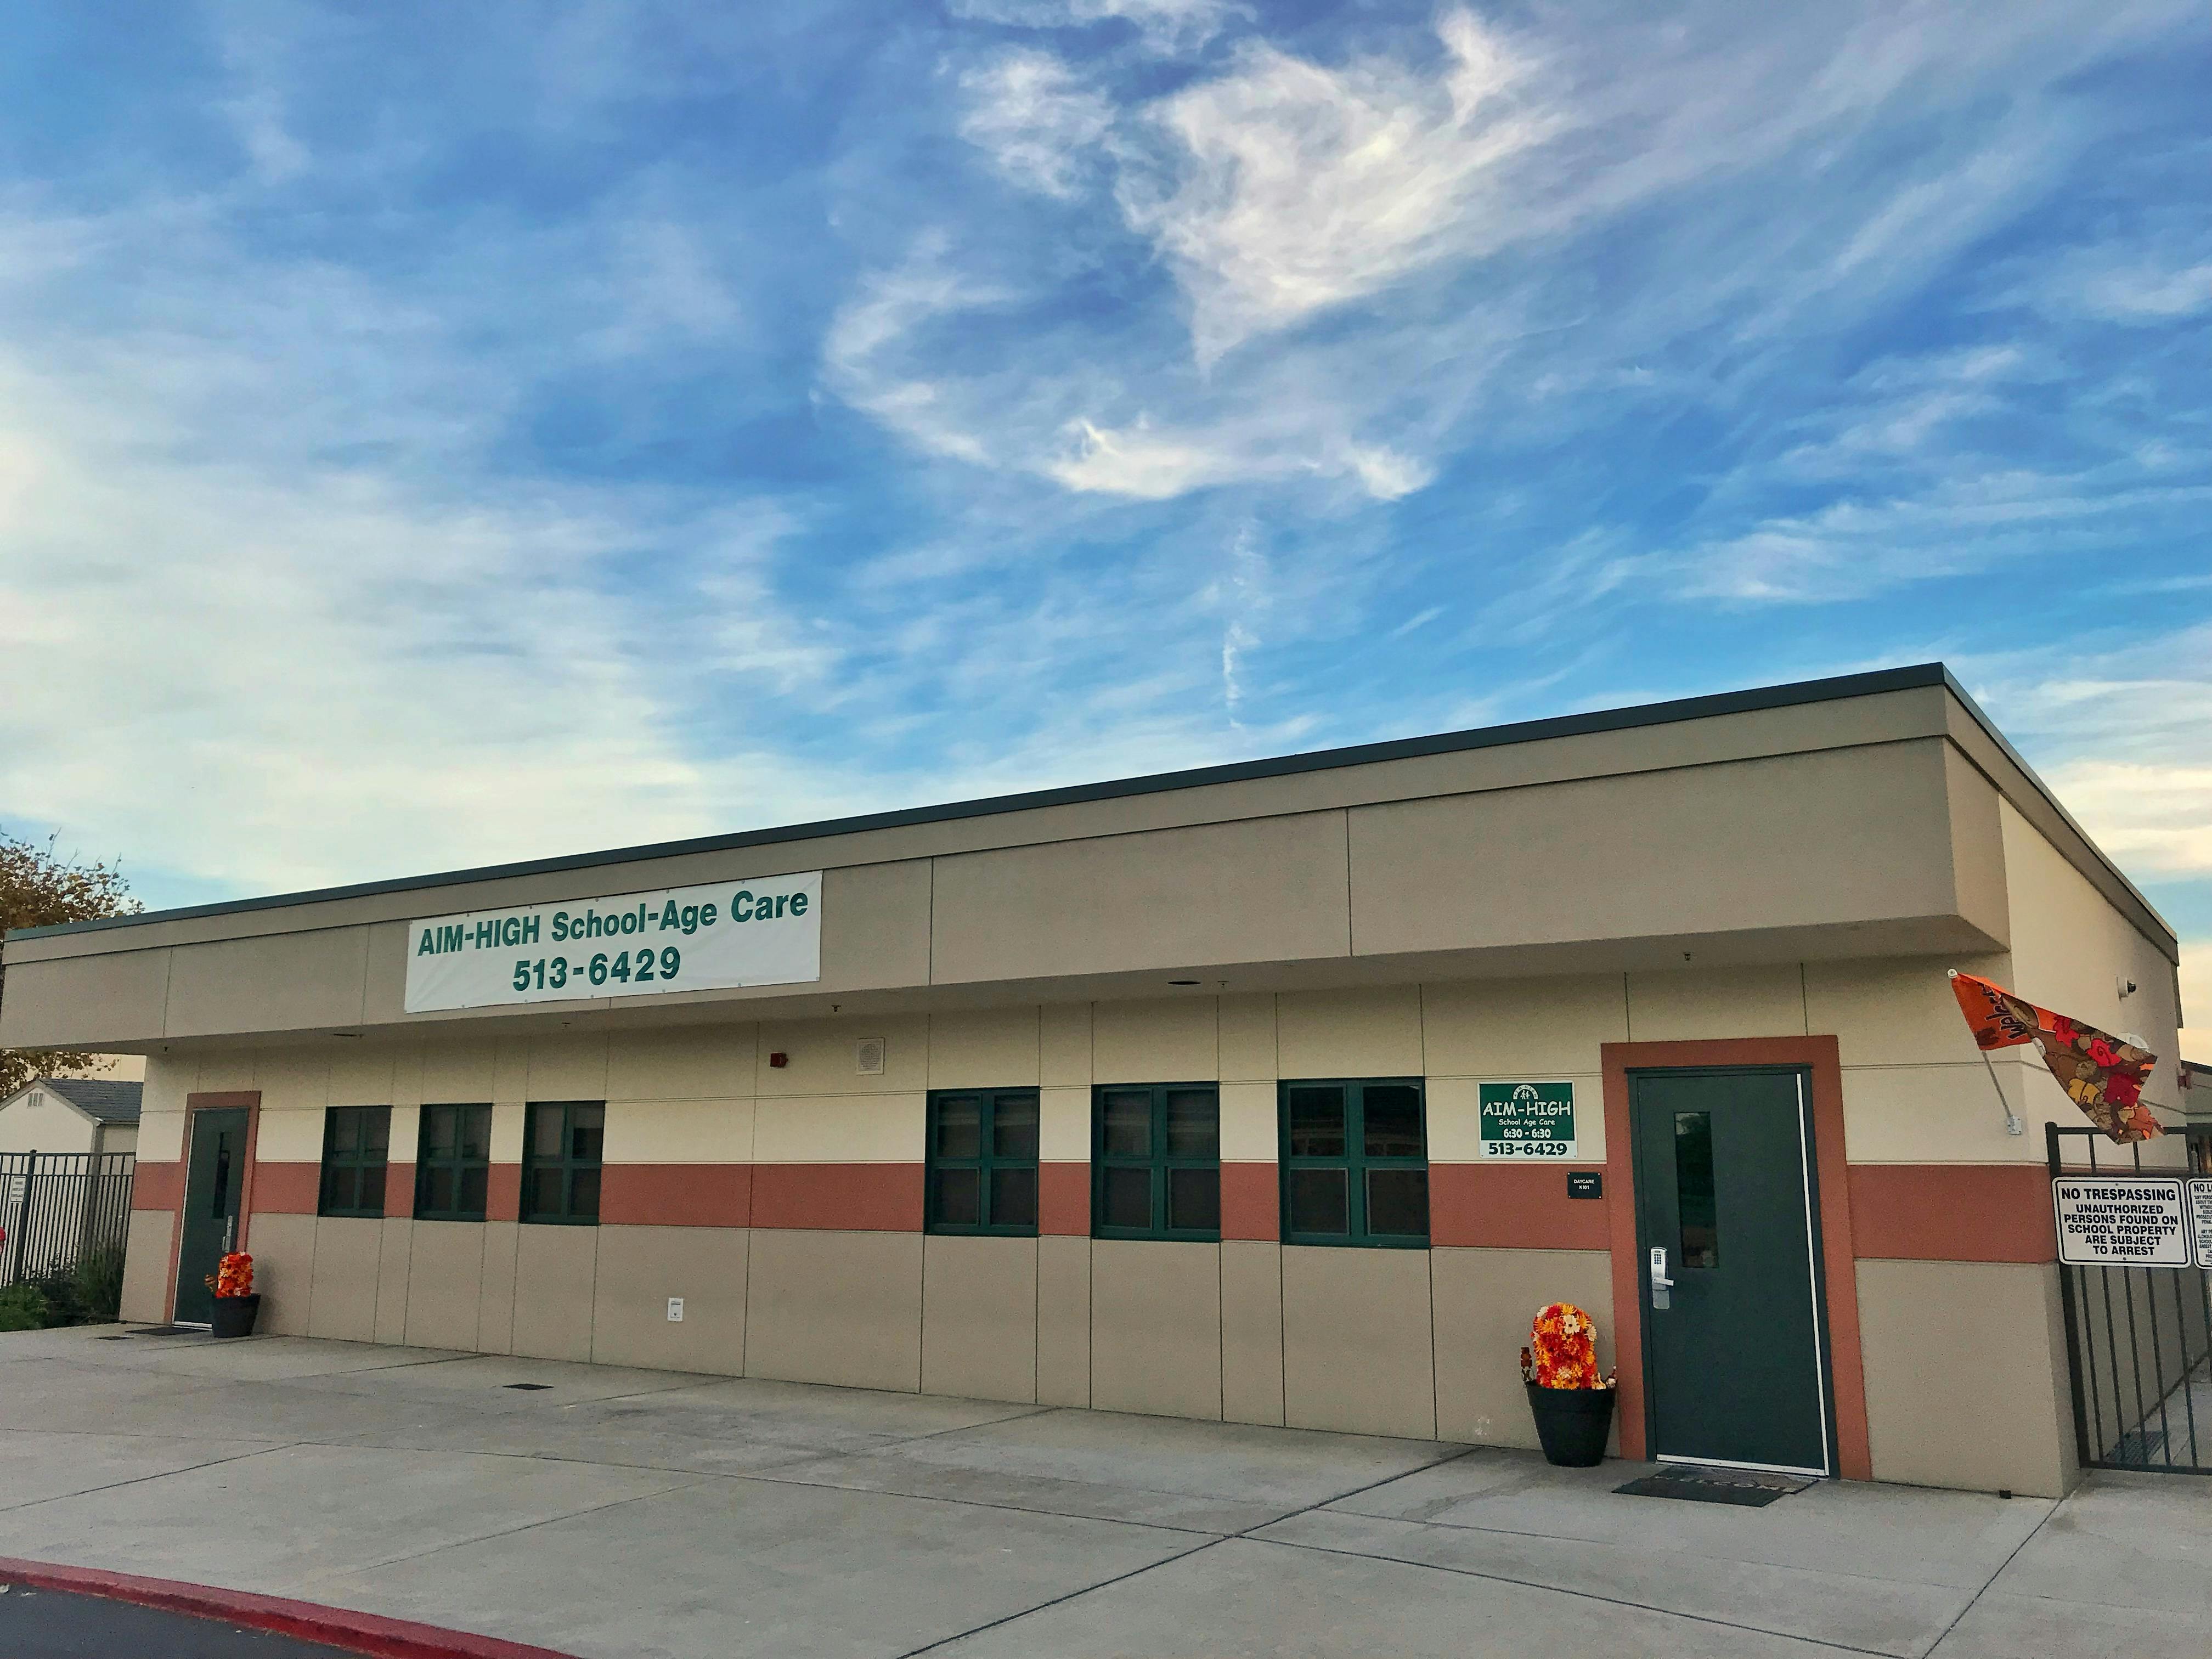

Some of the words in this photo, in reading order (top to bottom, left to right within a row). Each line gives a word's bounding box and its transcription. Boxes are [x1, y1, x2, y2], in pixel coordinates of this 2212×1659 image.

[417, 915, 540, 956] AIM-HIGH
[552, 899, 717, 942] School-Age
[731, 890, 808, 923] Care
[512, 945, 681, 991] 513-6429
[1483, 1101, 1571, 1116] AIM-HIGH
[1503, 1128, 1522, 1138] 6:30
[1532, 1128, 1551, 1138] 6:30
[1489, 1142, 1567, 1155] 513-6429
[2061, 1188, 2080, 1200] NO
[2084, 1188, 2176, 1201] TRESPASSING
[2076, 1204, 2164, 1214] UNAUTHORIZED
[2064, 1214, 2116, 1224] PERSONS
[2120, 1215, 2158, 1224] FOUND
[2162, 1216, 2179, 1225] ON
[2068, 1225, 2114, 1234] SCHOOL
[2117, 1225, 2176, 1235] PROPERTY
[2085, 1235, 2107, 1244] ARE
[2111, 1235, 2161, 1245] SUBJECT
[2093, 1245, 2108, 1255] TO
[2112, 1246, 2155, 1255] ARREST
